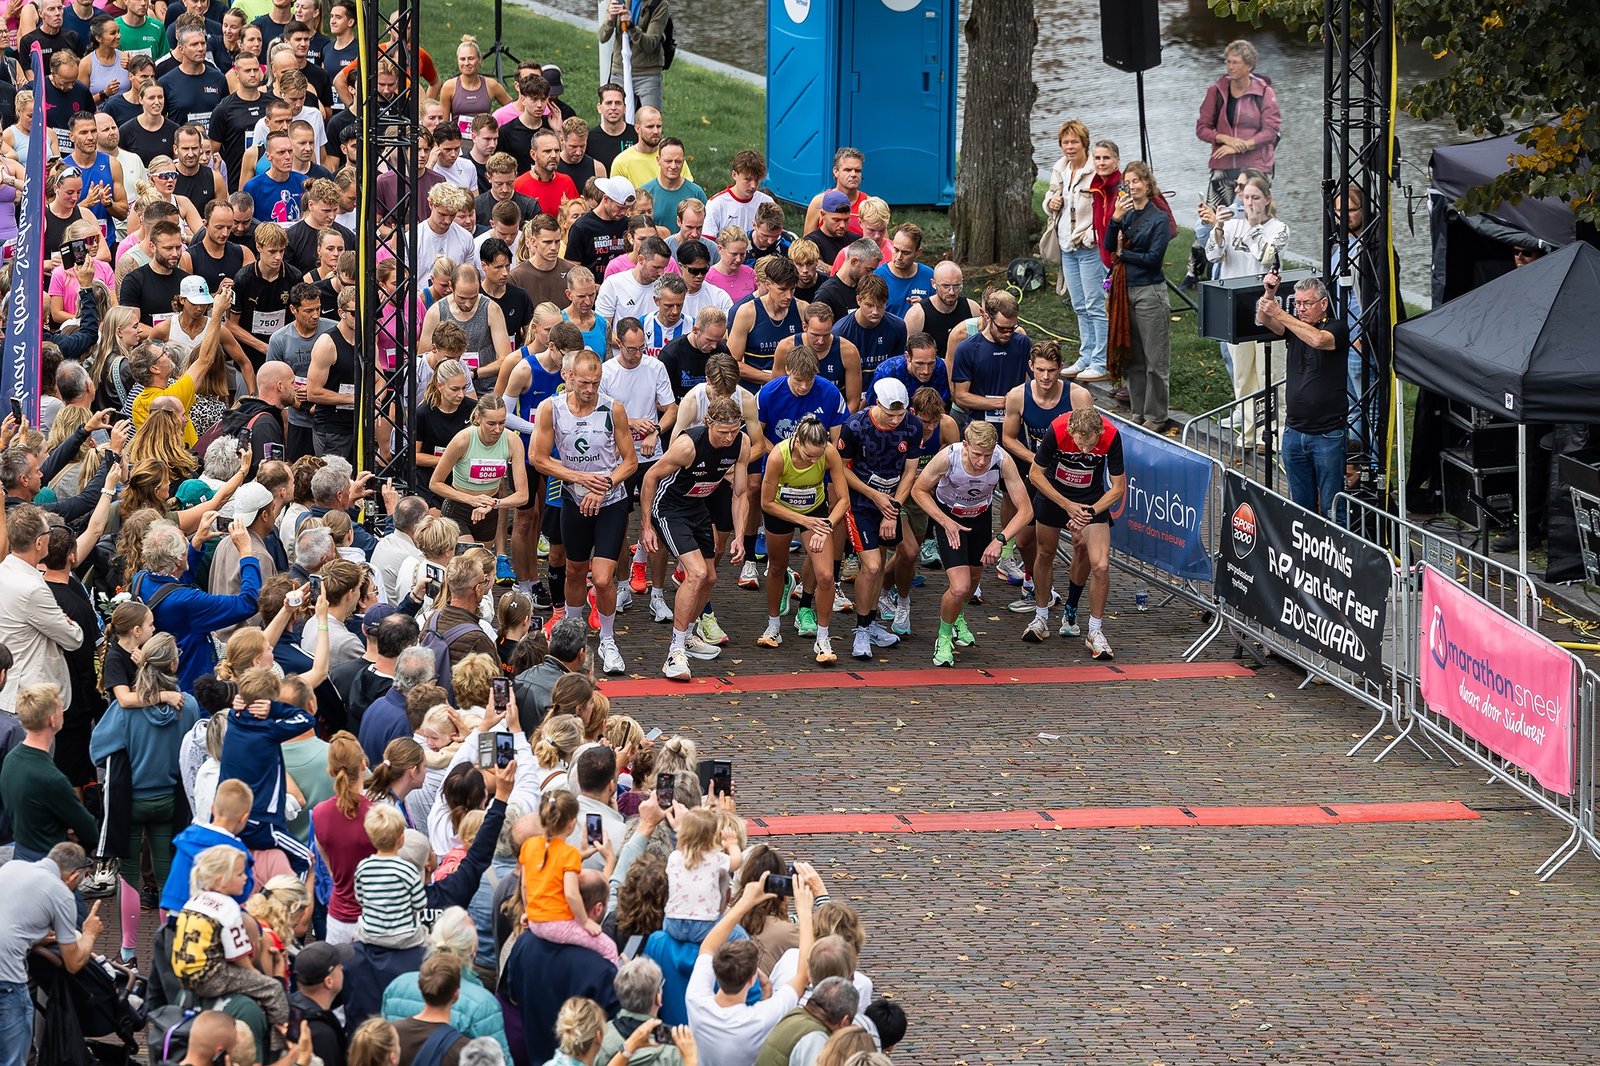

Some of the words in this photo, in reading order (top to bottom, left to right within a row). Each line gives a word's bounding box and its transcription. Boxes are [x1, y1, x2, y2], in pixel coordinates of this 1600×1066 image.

[259, 318, 280, 327] 7507
[566, 453, 600, 463] runpoint
[1128, 477, 1197, 532] fryslân
[1233, 516, 1255, 534] SPORT
[1128, 519, 1145, 532] meer
[1145, 525, 1160, 538] dan
[1161, 531, 1186, 549] nieuws
[1233, 529, 1252, 545] 2000
[1291, 520, 1353, 579] Sporthuis
[1294, 567, 1321, 600] van
[1323, 577, 1344, 611] der
[1345, 588, 1379, 630] Feer
[1280, 597, 1366, 663] BOLSWARD
[1459, 677, 1480, 712] dwars
[1482, 694, 1502, 723] door
[1502, 707, 1546, 746] Súdwest
